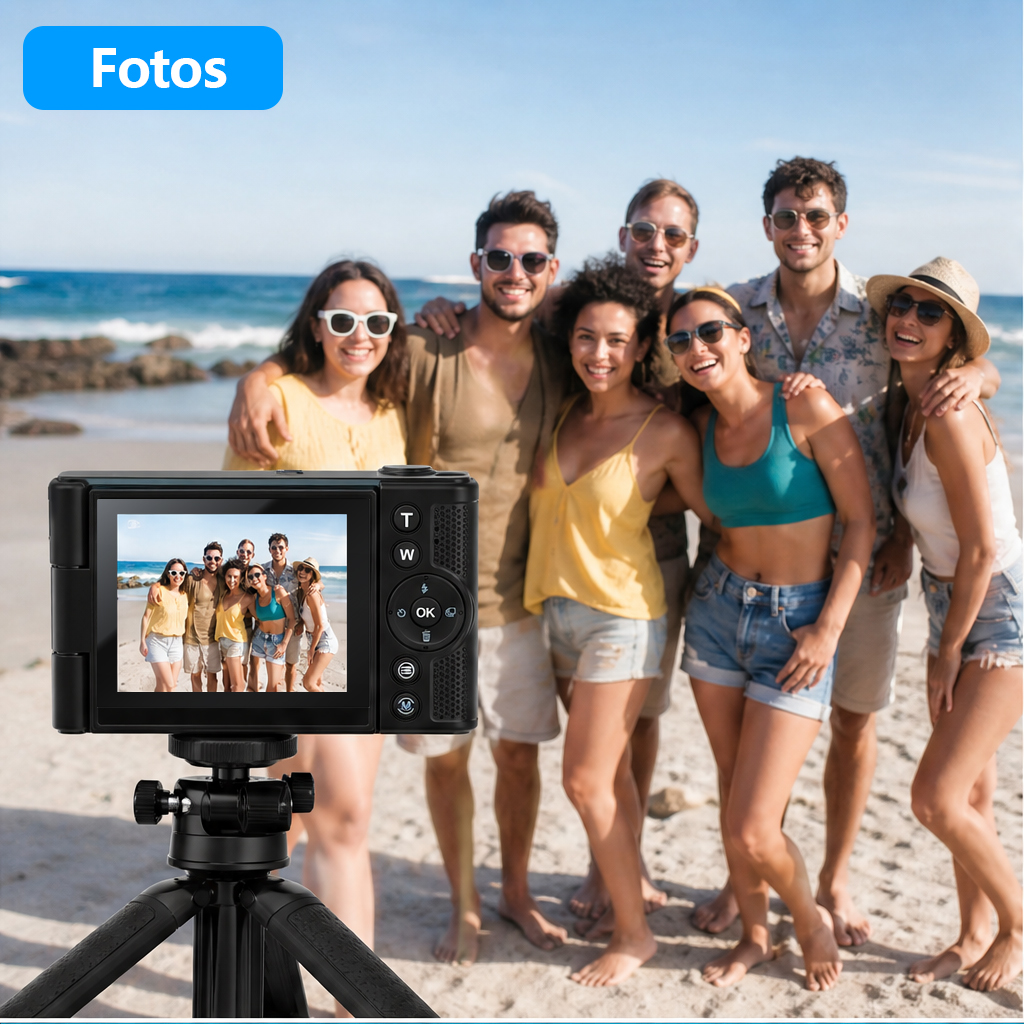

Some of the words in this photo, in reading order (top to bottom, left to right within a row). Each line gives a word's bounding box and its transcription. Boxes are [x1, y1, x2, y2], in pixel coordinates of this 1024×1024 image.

[400, 512, 414, 528] T
[399, 548, 415, 561] W
[415, 607, 436, 618] OK
